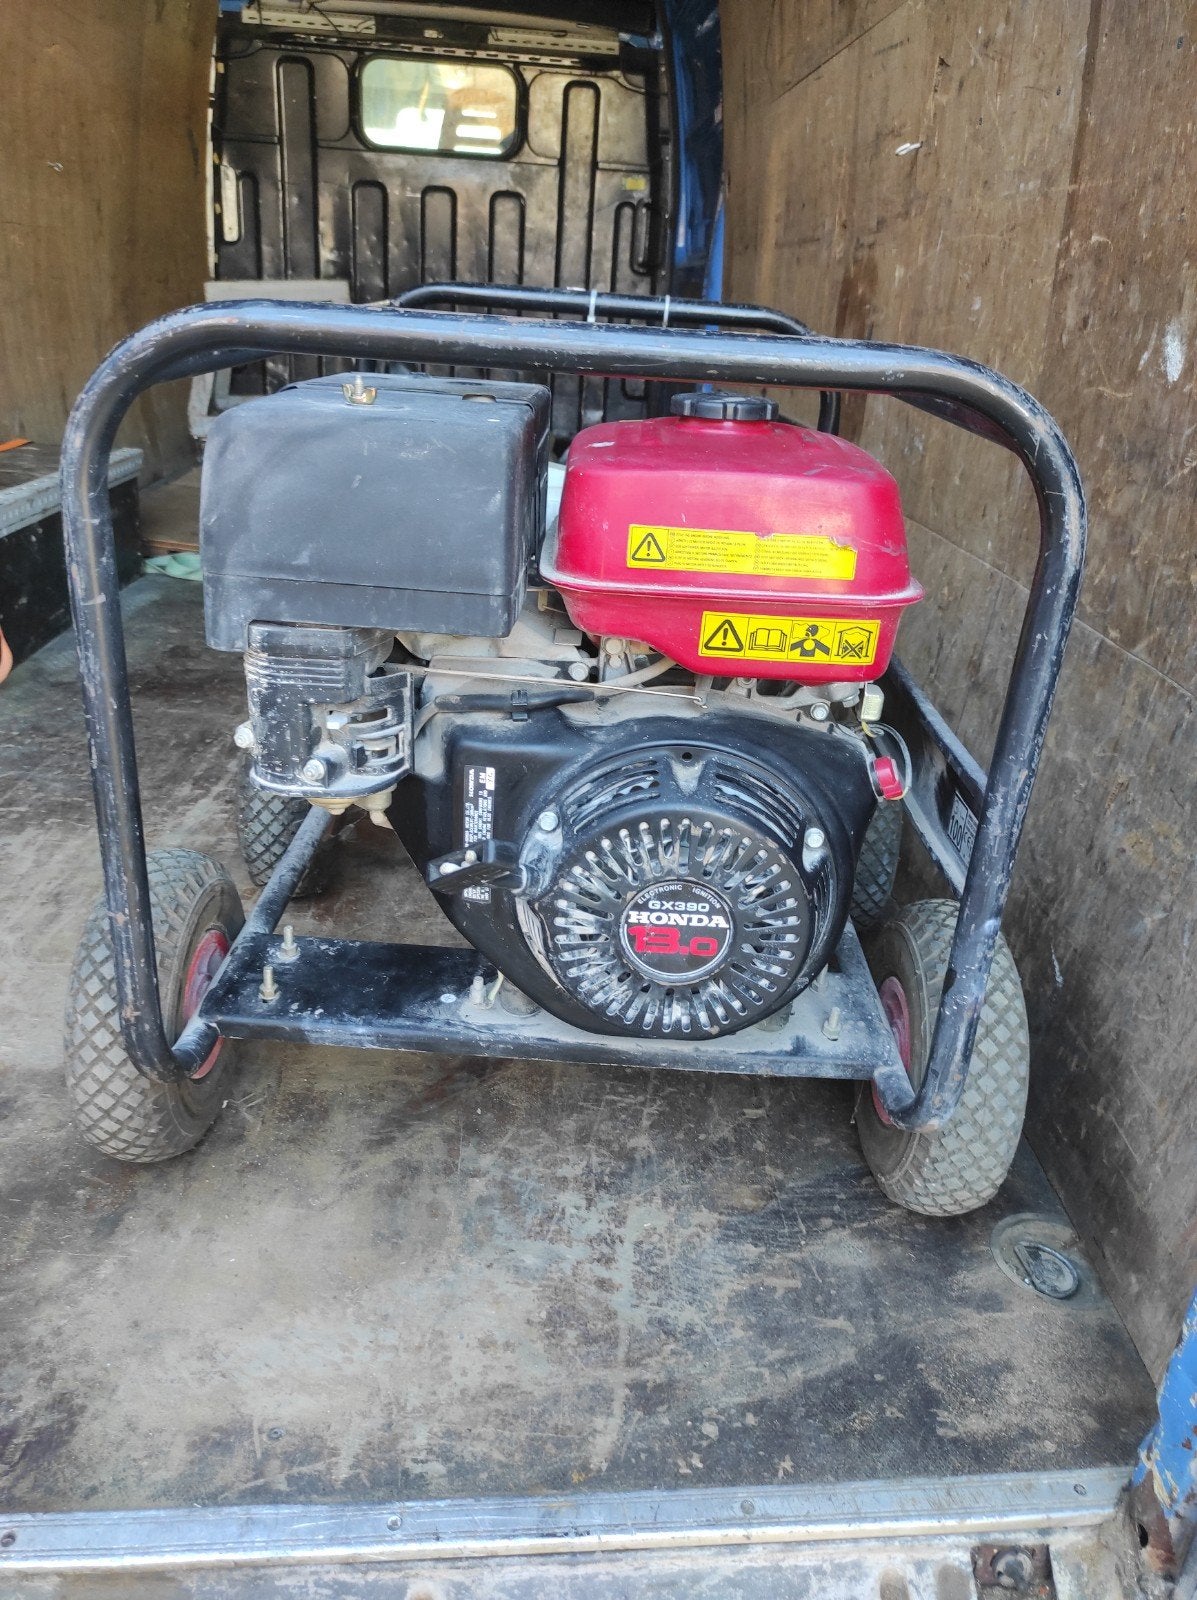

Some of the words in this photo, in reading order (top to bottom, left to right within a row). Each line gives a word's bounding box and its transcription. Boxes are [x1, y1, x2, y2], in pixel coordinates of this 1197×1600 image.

[950, 815, 962, 846] 100
[637, 885, 683, 904] ELECTRONIC
[692, 887, 722, 909] IGNITION
[648, 900, 710, 912] GX390
[628, 911, 729, 928] HONDA
[628, 925, 719, 957] 13.0
